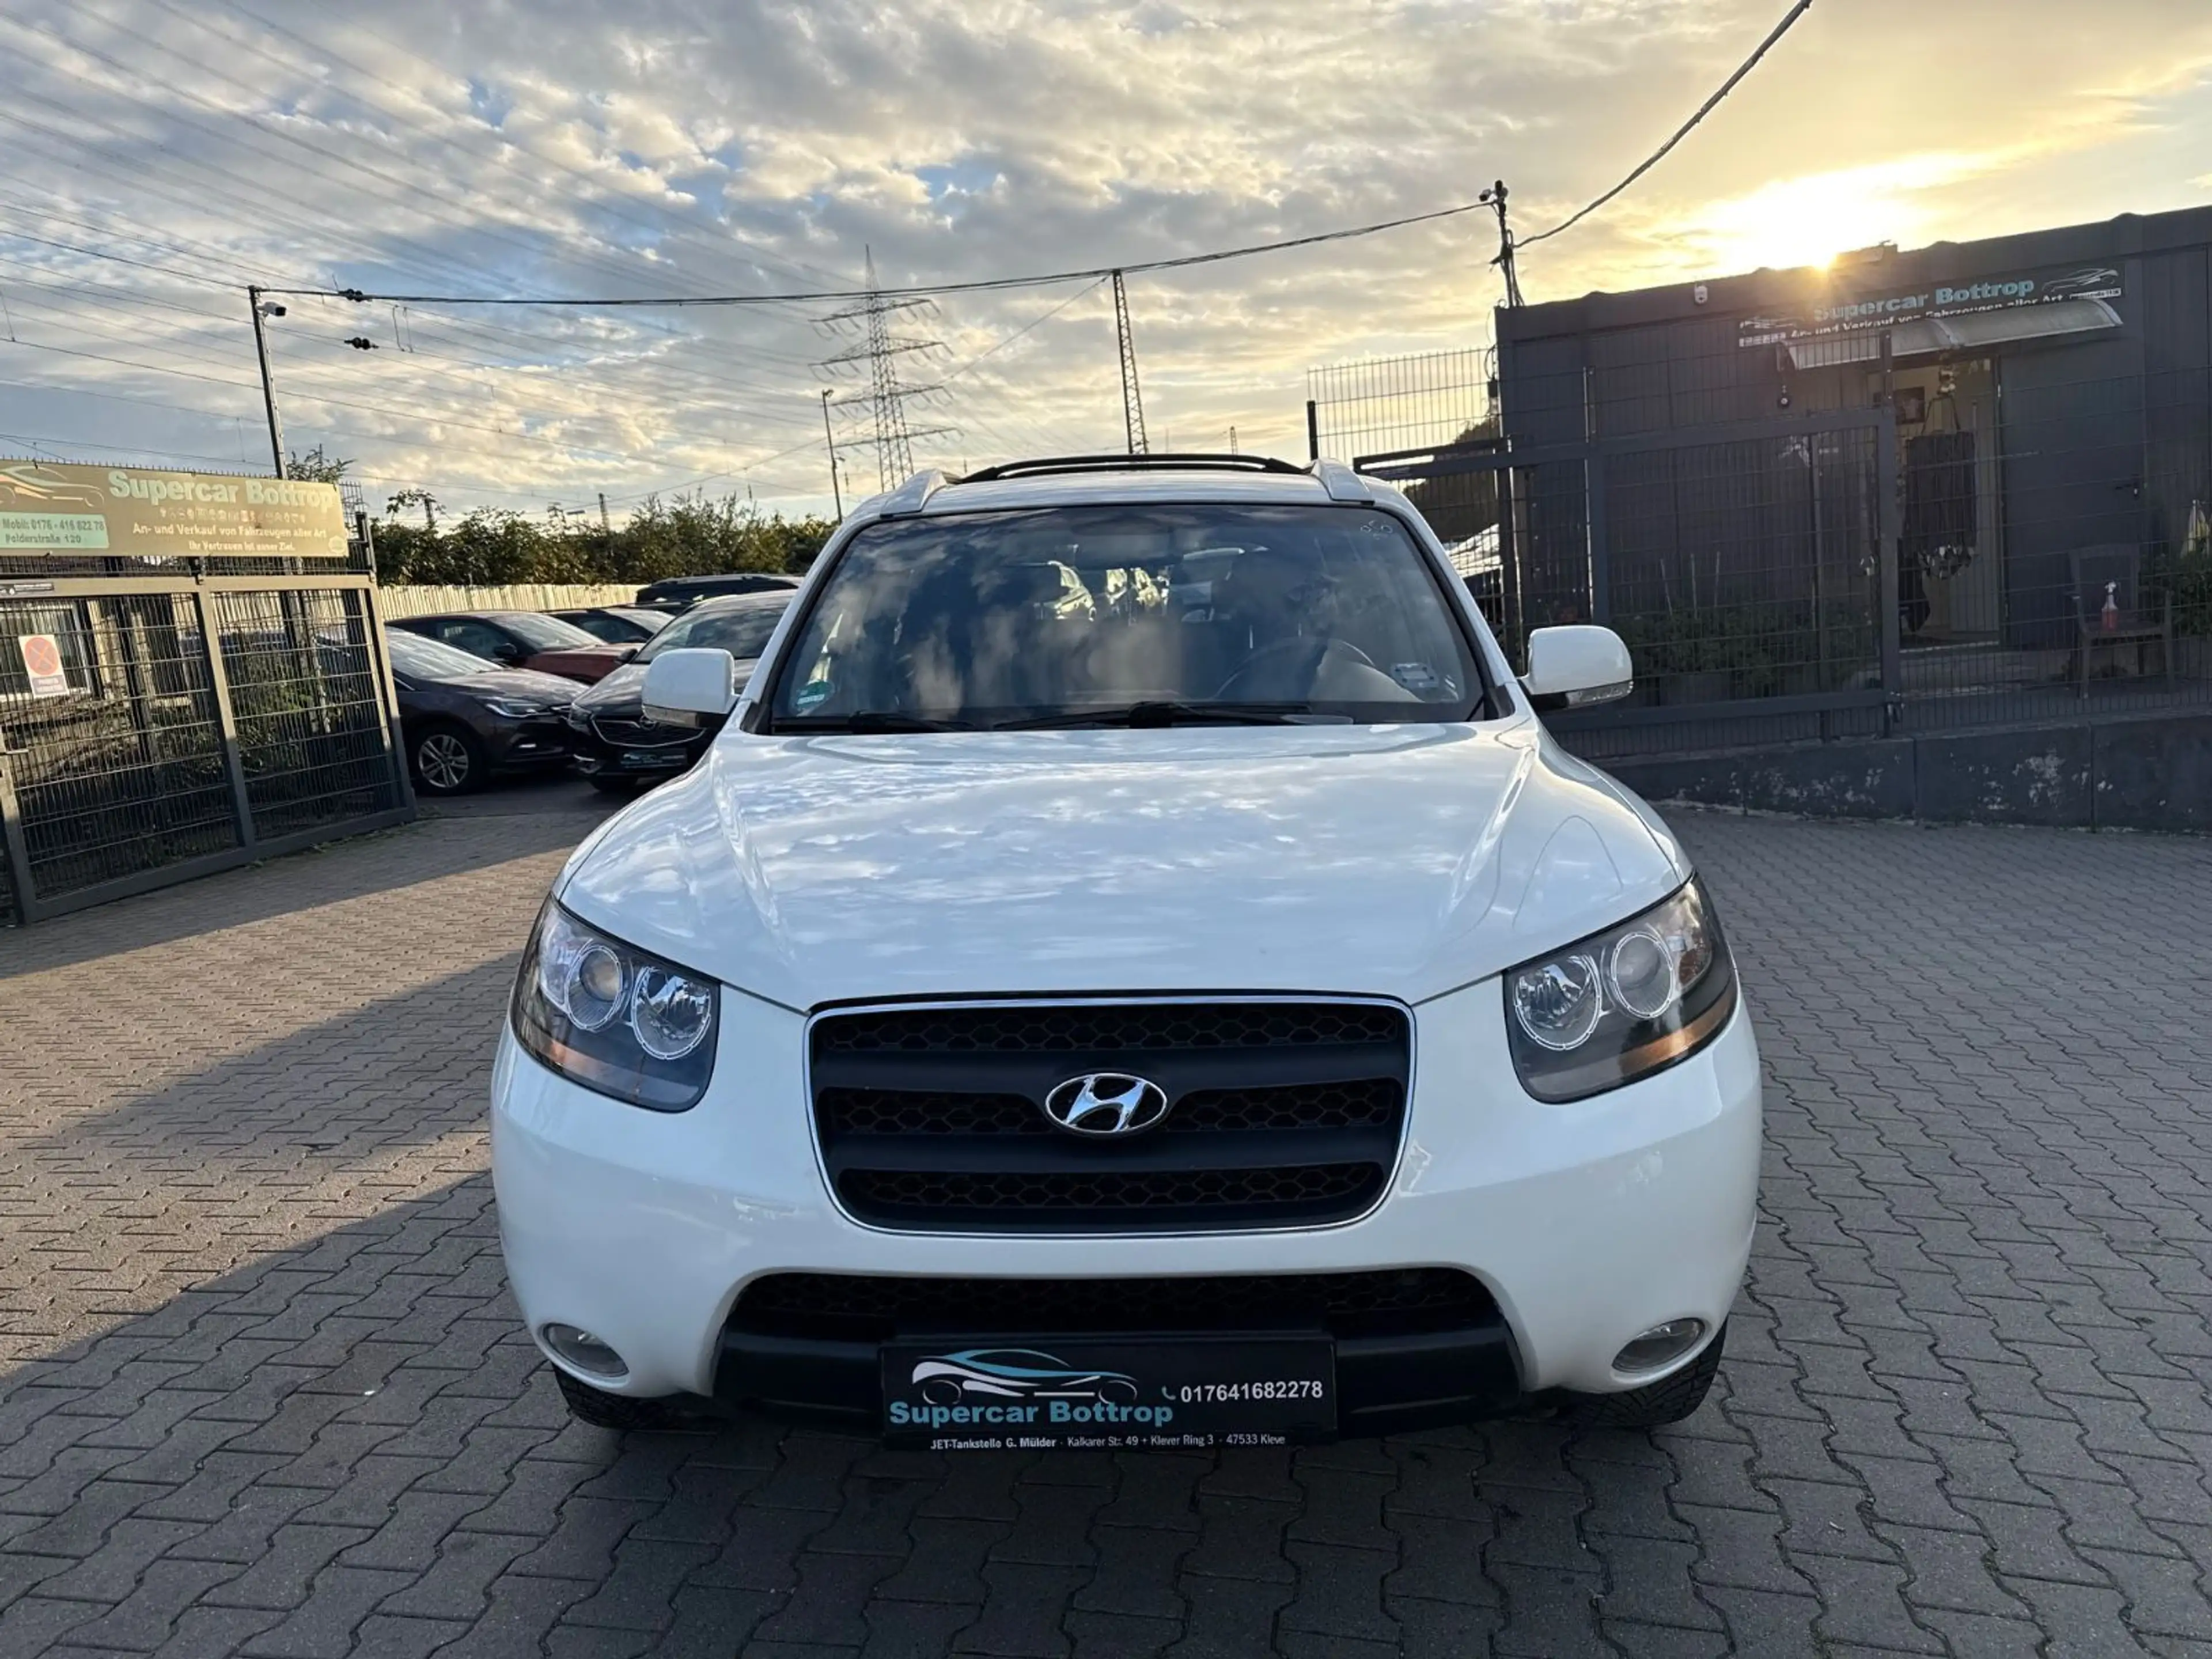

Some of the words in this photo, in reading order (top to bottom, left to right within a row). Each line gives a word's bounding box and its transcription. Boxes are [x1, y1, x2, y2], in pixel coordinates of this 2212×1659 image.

[1814, 294, 1929, 322] Supercar
[1936, 280, 2034, 305] Bottrop
[108, 470, 238, 506] Supercar
[245, 479, 336, 514] Bottrop
[65, 534, 81, 543] 120
[132, 522, 152, 535] An-
[154, 524, 174, 535] und
[176, 524, 216, 536] Verkauf
[219, 526, 237, 537] von
[1180, 1381, 1323, 1403] 017641682278
[889, 1400, 1039, 1429] Supercar
[1049, 1400, 1173, 1428] Bottrop
[1006, 1437, 1017, 1448] G.
[1019, 1437, 1057, 1448] Mülder
[1126, 1435, 1139, 1446] 49
[1150, 1435, 1180, 1446] Klever
[1183, 1434, 1206, 1447] Ring
[1207, 1434, 1214, 1445] 3
[1225, 1434, 1258, 1445] 47533
[1260, 1434, 1286, 1445] Kleve
